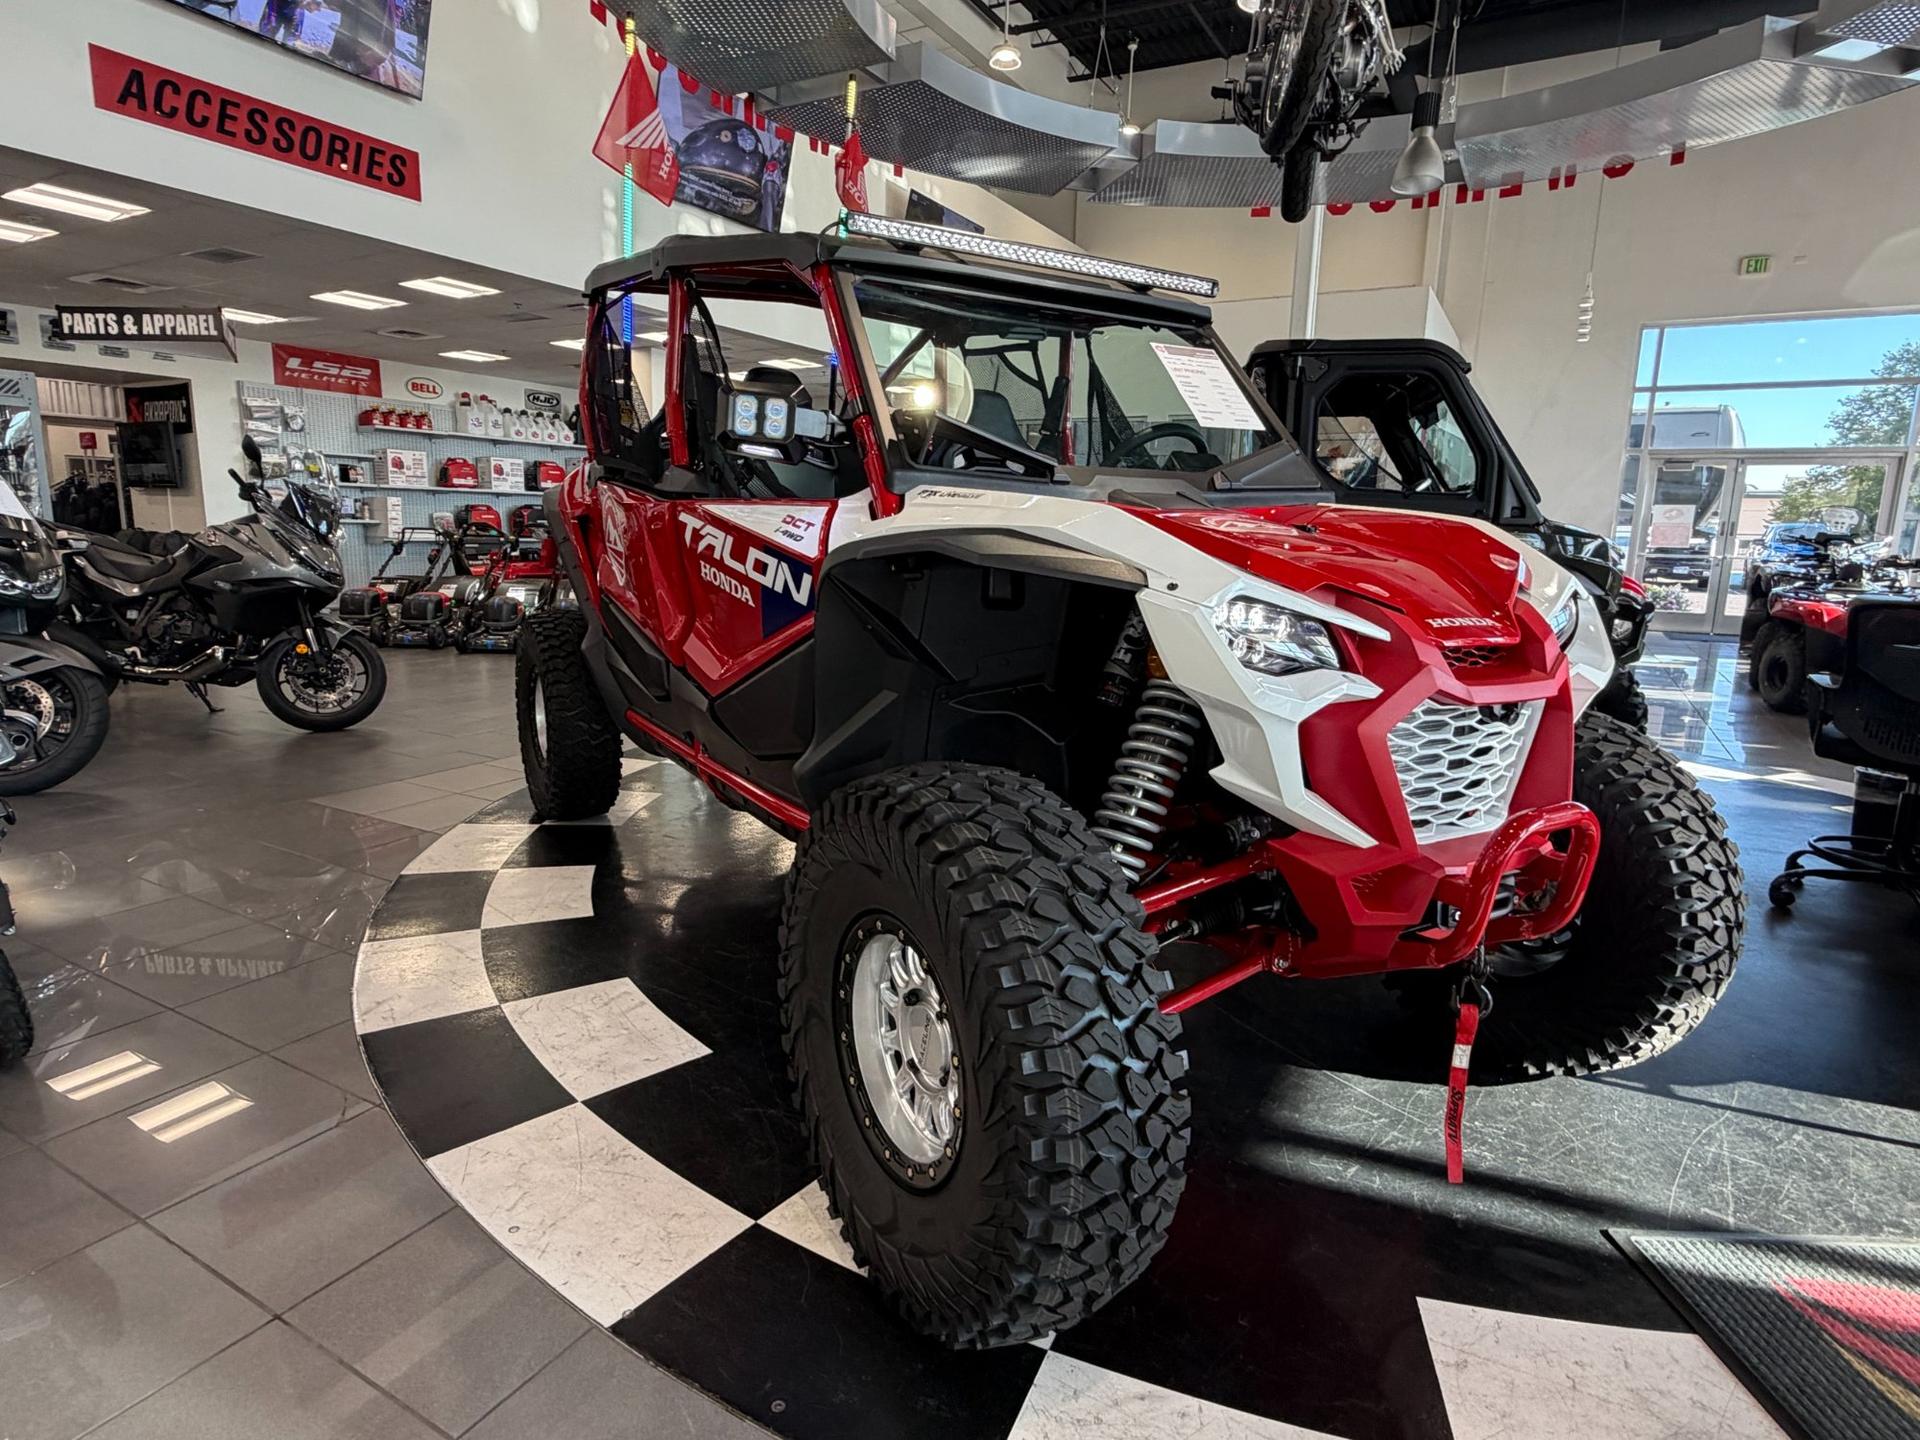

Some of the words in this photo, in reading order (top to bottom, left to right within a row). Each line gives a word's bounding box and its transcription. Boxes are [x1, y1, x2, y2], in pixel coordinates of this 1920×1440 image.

[116, 69, 409, 188] ACCESSORIES
[1746, 257, 1769, 274] EXIT
[61, 312, 119, 335] PARTS
[123, 314, 138, 335] &
[142, 313, 219, 336] APPAREL
[285, 357, 372, 379] LS2
[284, 371, 369, 388] HELMETS
[410, 381, 439, 395] BELL
[531, 394, 556, 406] HJC
[781, 514, 816, 532] DCT
[678, 511, 813, 607] TALON
[699, 560, 756, 608] HONDA
[1424, 616, 1503, 629] HONDA
